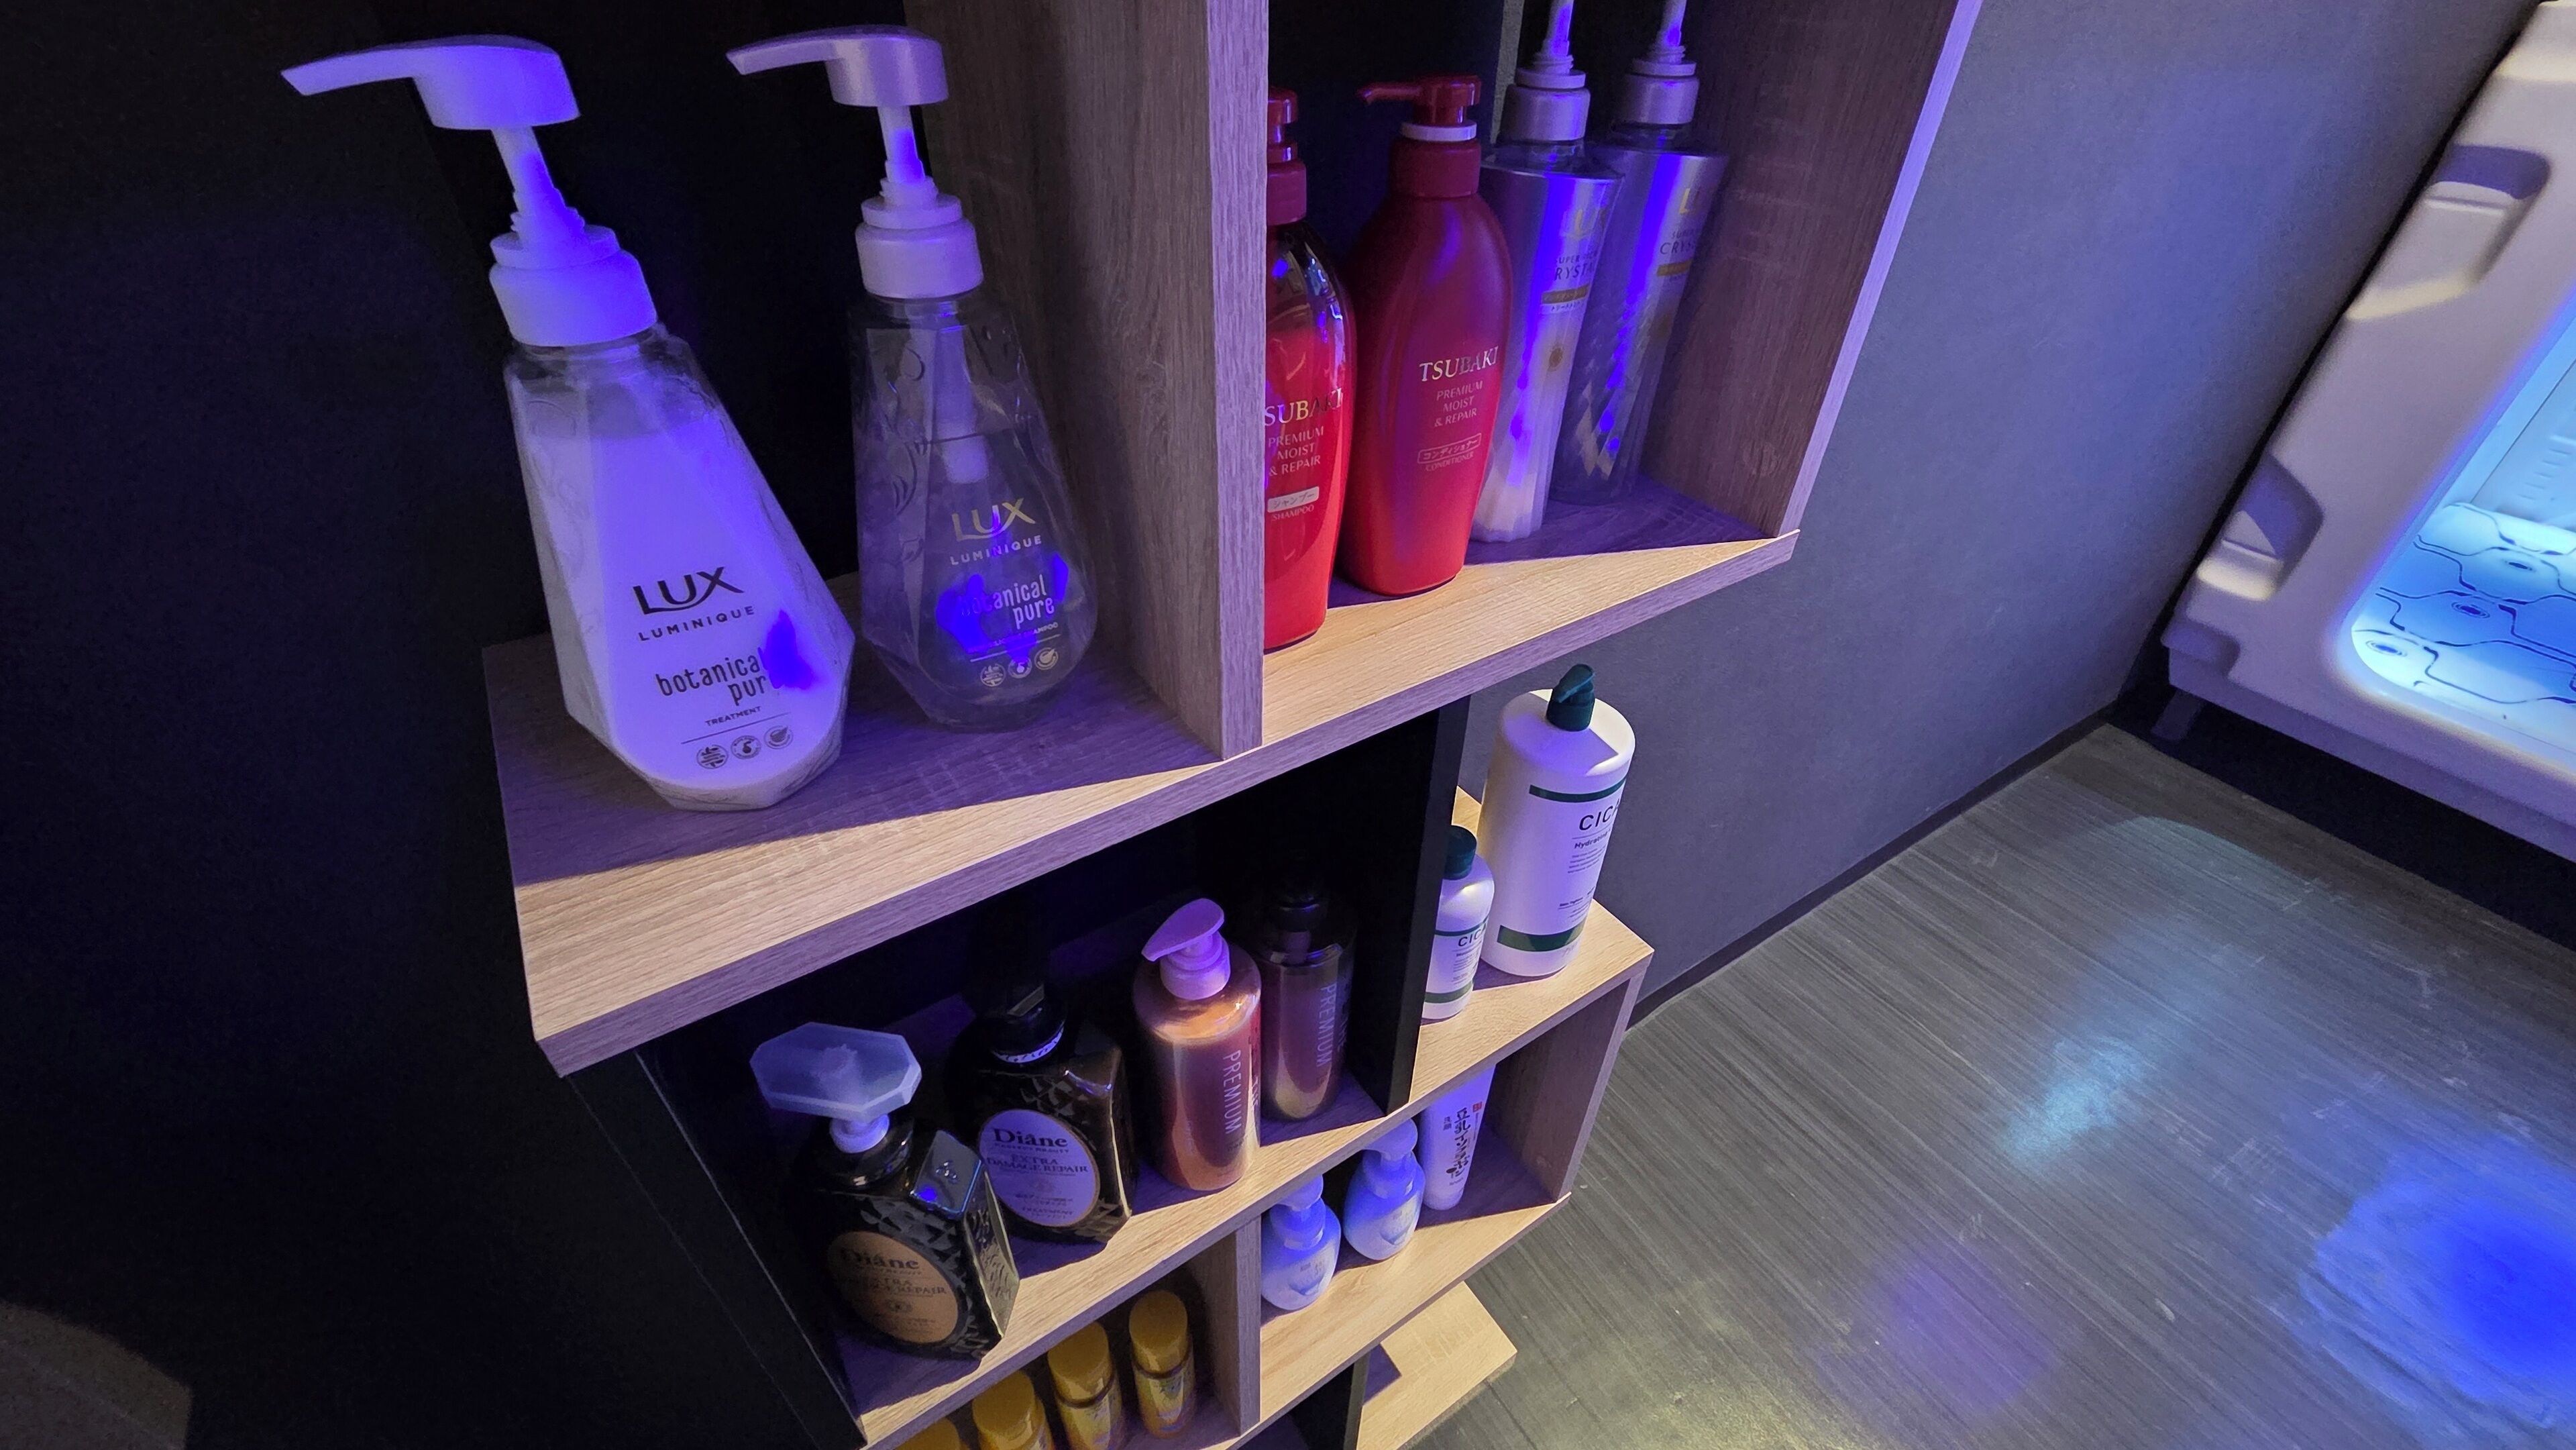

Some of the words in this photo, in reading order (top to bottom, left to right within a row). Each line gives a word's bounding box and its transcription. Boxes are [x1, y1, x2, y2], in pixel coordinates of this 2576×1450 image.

[1419, 345, 1499, 382] TSUBAKI
[1436, 380, 1483, 401] PREMIUM
[1443, 395, 1474, 413] MOIST
[1434, 417, 1443, 427] &
[1445, 407, 1477, 425] REPAIR
[1268, 426, 1324, 448] PREMIUM
[1277, 442, 1316, 460] MOIST
[1425, 450, 1474, 472] CONDITIONER
[1269, 466, 1278, 477] &
[1281, 455, 1321, 475] REPAIR
[1273, 491, 1315, 509] シャンプー
[951, 498, 1036, 542] LUX
[1272, 504, 1315, 522] SHAMPOO
[950, 535, 1042, 566] LUMINIQUE
[633, 566, 745, 615] LUX
[639, 605, 755, 641] LUMINIQUE
[1012, 597, 1055, 630] pure
[727, 674, 769, 707] pur
[705, 706, 761, 727] TREATMENT
[1317, 982, 1338, 1068] PREMIUM
[1222, 1049, 1242, 1135] PREMIUM
